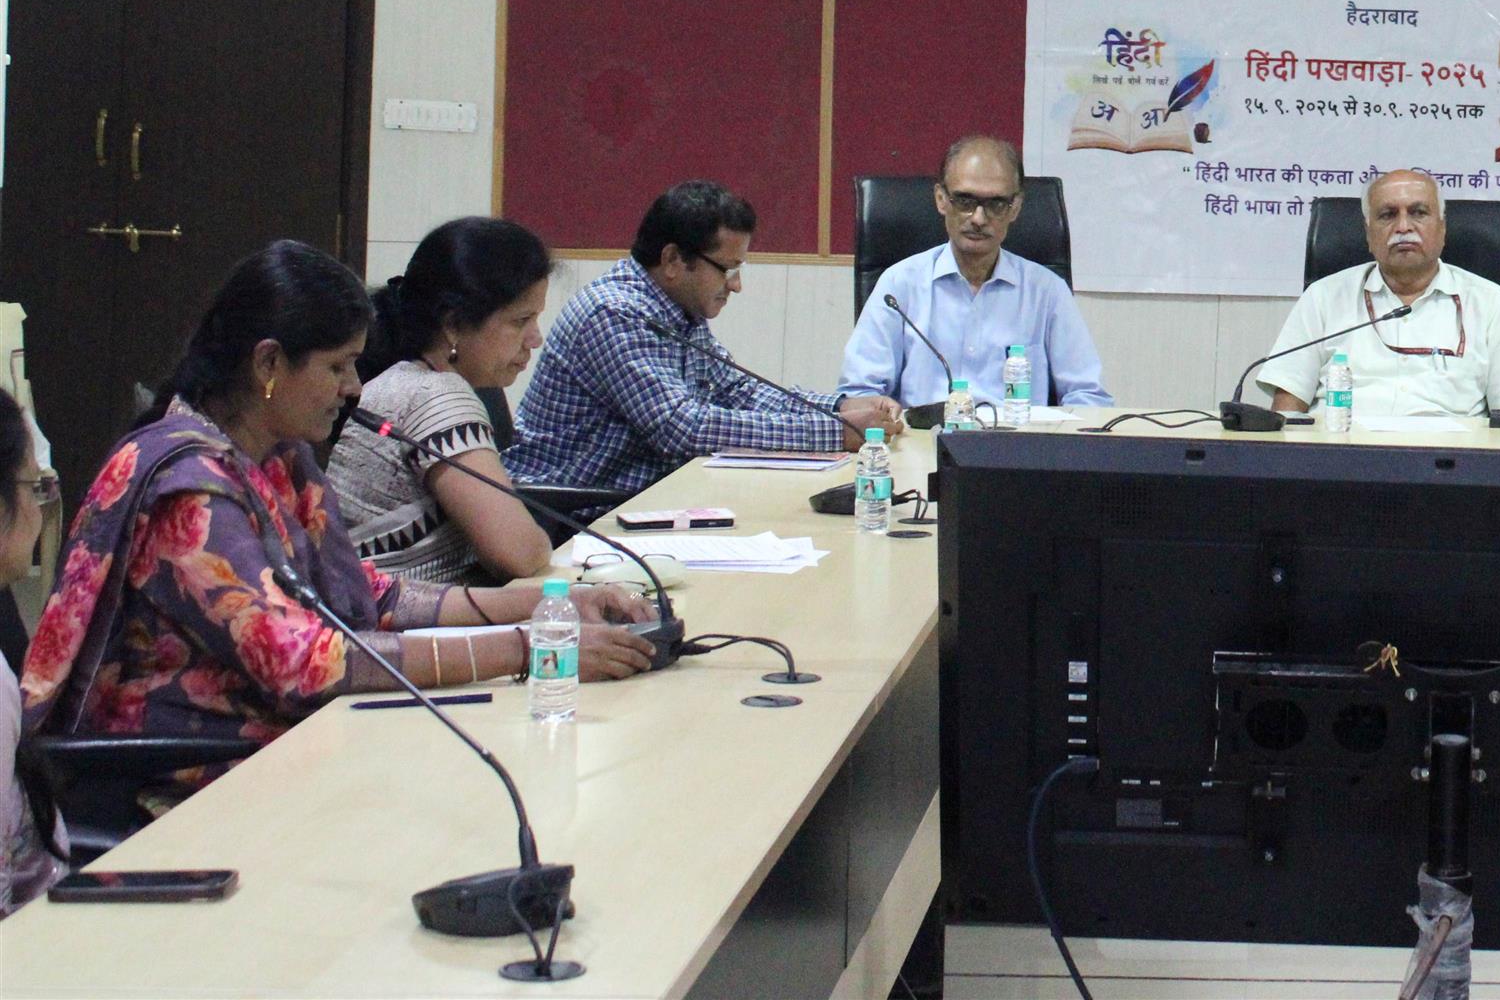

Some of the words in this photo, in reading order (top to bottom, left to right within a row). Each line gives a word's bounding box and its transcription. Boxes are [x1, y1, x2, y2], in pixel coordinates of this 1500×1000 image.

[1346, 1, 1418, 27] हैदराबाद
[1098, 28, 1167, 72] हिंदी
[1245, 49, 1299, 83] हिंदी
[1420, 61, 1487, 88] २०२५
[1091, 100, 1119, 122] अ
[1296, 99, 1340, 117] २०२५
[1342, 96, 1359, 116] से
[1409, 102, 1452, 121] २०२५
[1455, 103, 1486, 120] तक
[1195, 161, 1230, 183] हिंदी
[1235, 166, 1277, 184] भारत
[1281, 164, 1304, 184] की
[1308, 169, 1355, 187] एकता
[1359, 165, 1388, 184] औ
[1468, 169, 1490, 190] की
[1204, 193, 1240, 216] हिंदी
[1245, 199, 1281, 216] भाषा
[1286, 195, 1304, 216] तो
